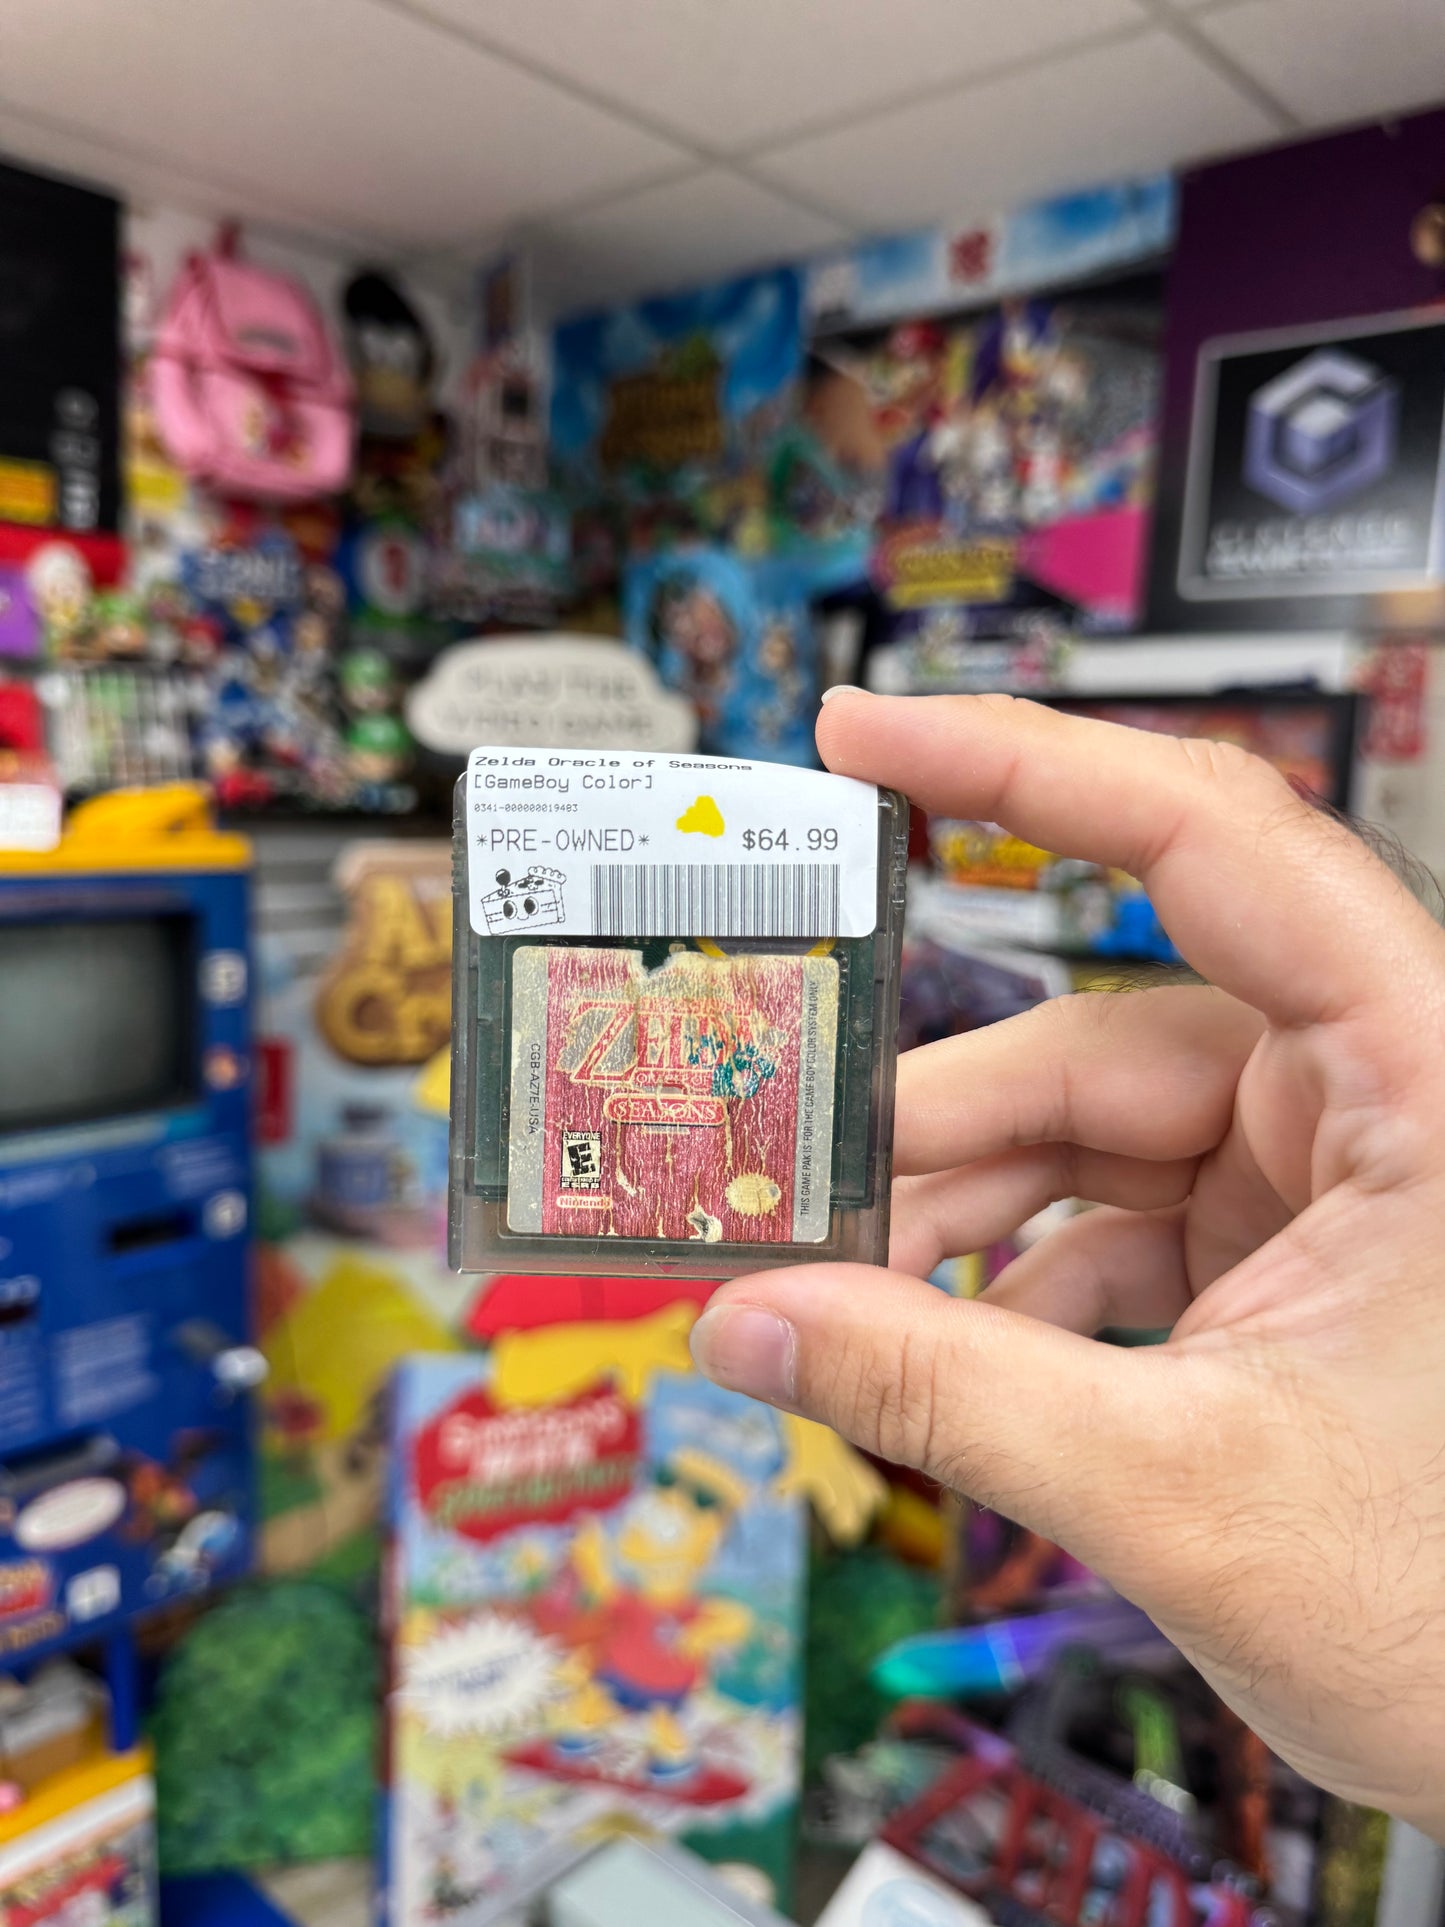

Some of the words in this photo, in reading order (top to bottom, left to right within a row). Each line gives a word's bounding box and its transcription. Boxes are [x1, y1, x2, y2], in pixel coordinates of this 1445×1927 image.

[475, 756, 536, 767] Zelda
[548, 757, 621, 768] Oracle
[633, 759, 656, 768] of
[668, 760, 753, 771] Seasons
[474, 773, 570, 793] [GameBoy
[582, 773, 653, 790] Color]
[742, 828, 839, 851] $64.99
[808, 1003, 818, 1037] SYSTEM
[807, 1037, 817, 1063] COLOR
[806, 1066, 816, 1082] BOY
[528, 1043, 541, 1135] CGB-AZ7E-USA
[805, 1084, 815, 1107] GAME
[613, 1099, 718, 1121] SEASONS
[805, 1109, 814, 1124] THE
[563, 1131, 601, 1140] EVERYONE
[803, 1126, 813, 1143] FOR
[803, 1144, 813, 1153] IS
[802, 1154, 812, 1171] PAK
[801, 1172, 811, 1196] GAME
[560, 1197, 611, 1207] Nintendo
[800, 1197, 810, 1216] THIS
